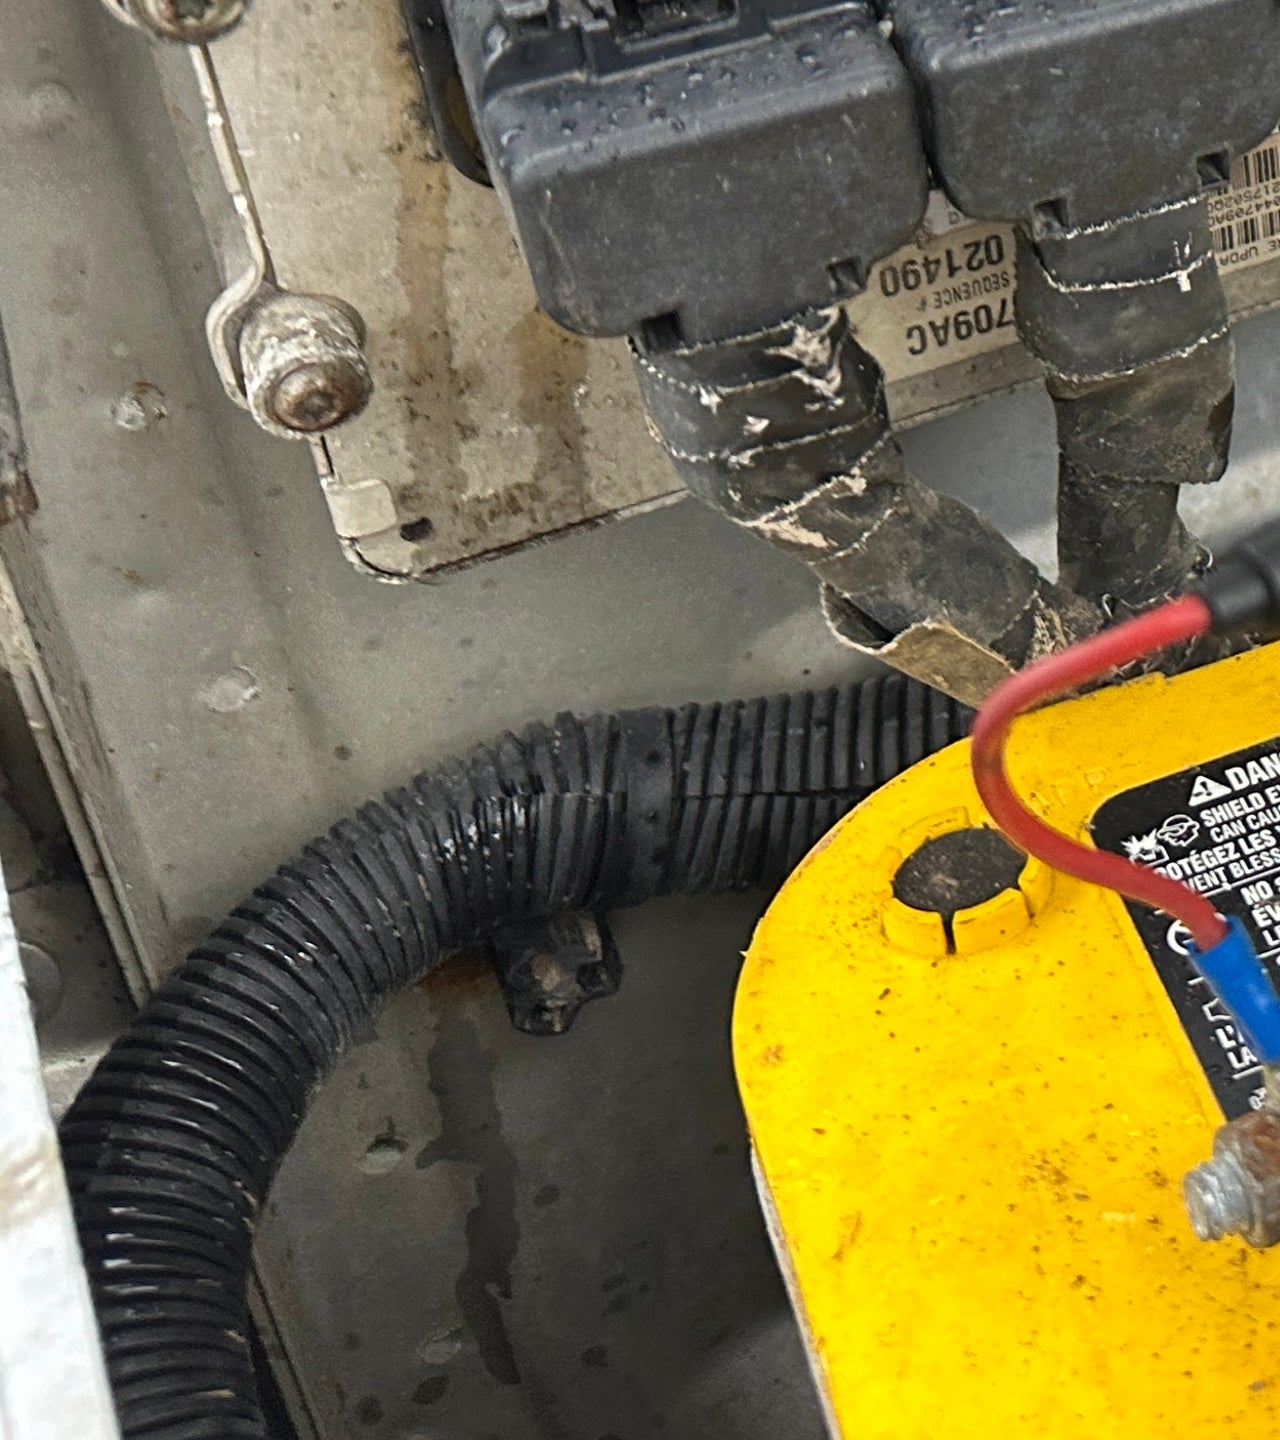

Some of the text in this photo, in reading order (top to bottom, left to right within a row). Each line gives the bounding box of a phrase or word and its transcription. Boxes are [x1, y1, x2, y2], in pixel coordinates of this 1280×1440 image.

[880, 234, 1004, 297] 021490
[1219, 246, 1259, 266] UPDA
[934, 271, 1010, 309] SEQUENCE
[906, 297, 1013, 355] 709AC
[1199, 792, 1266, 827] SHIELD
[1209, 819, 1247, 843] CAN
[1237, 829, 1276, 855] LES
[1240, 880, 1273, 905] NO
[1227, 1046, 1258, 1069] LA
